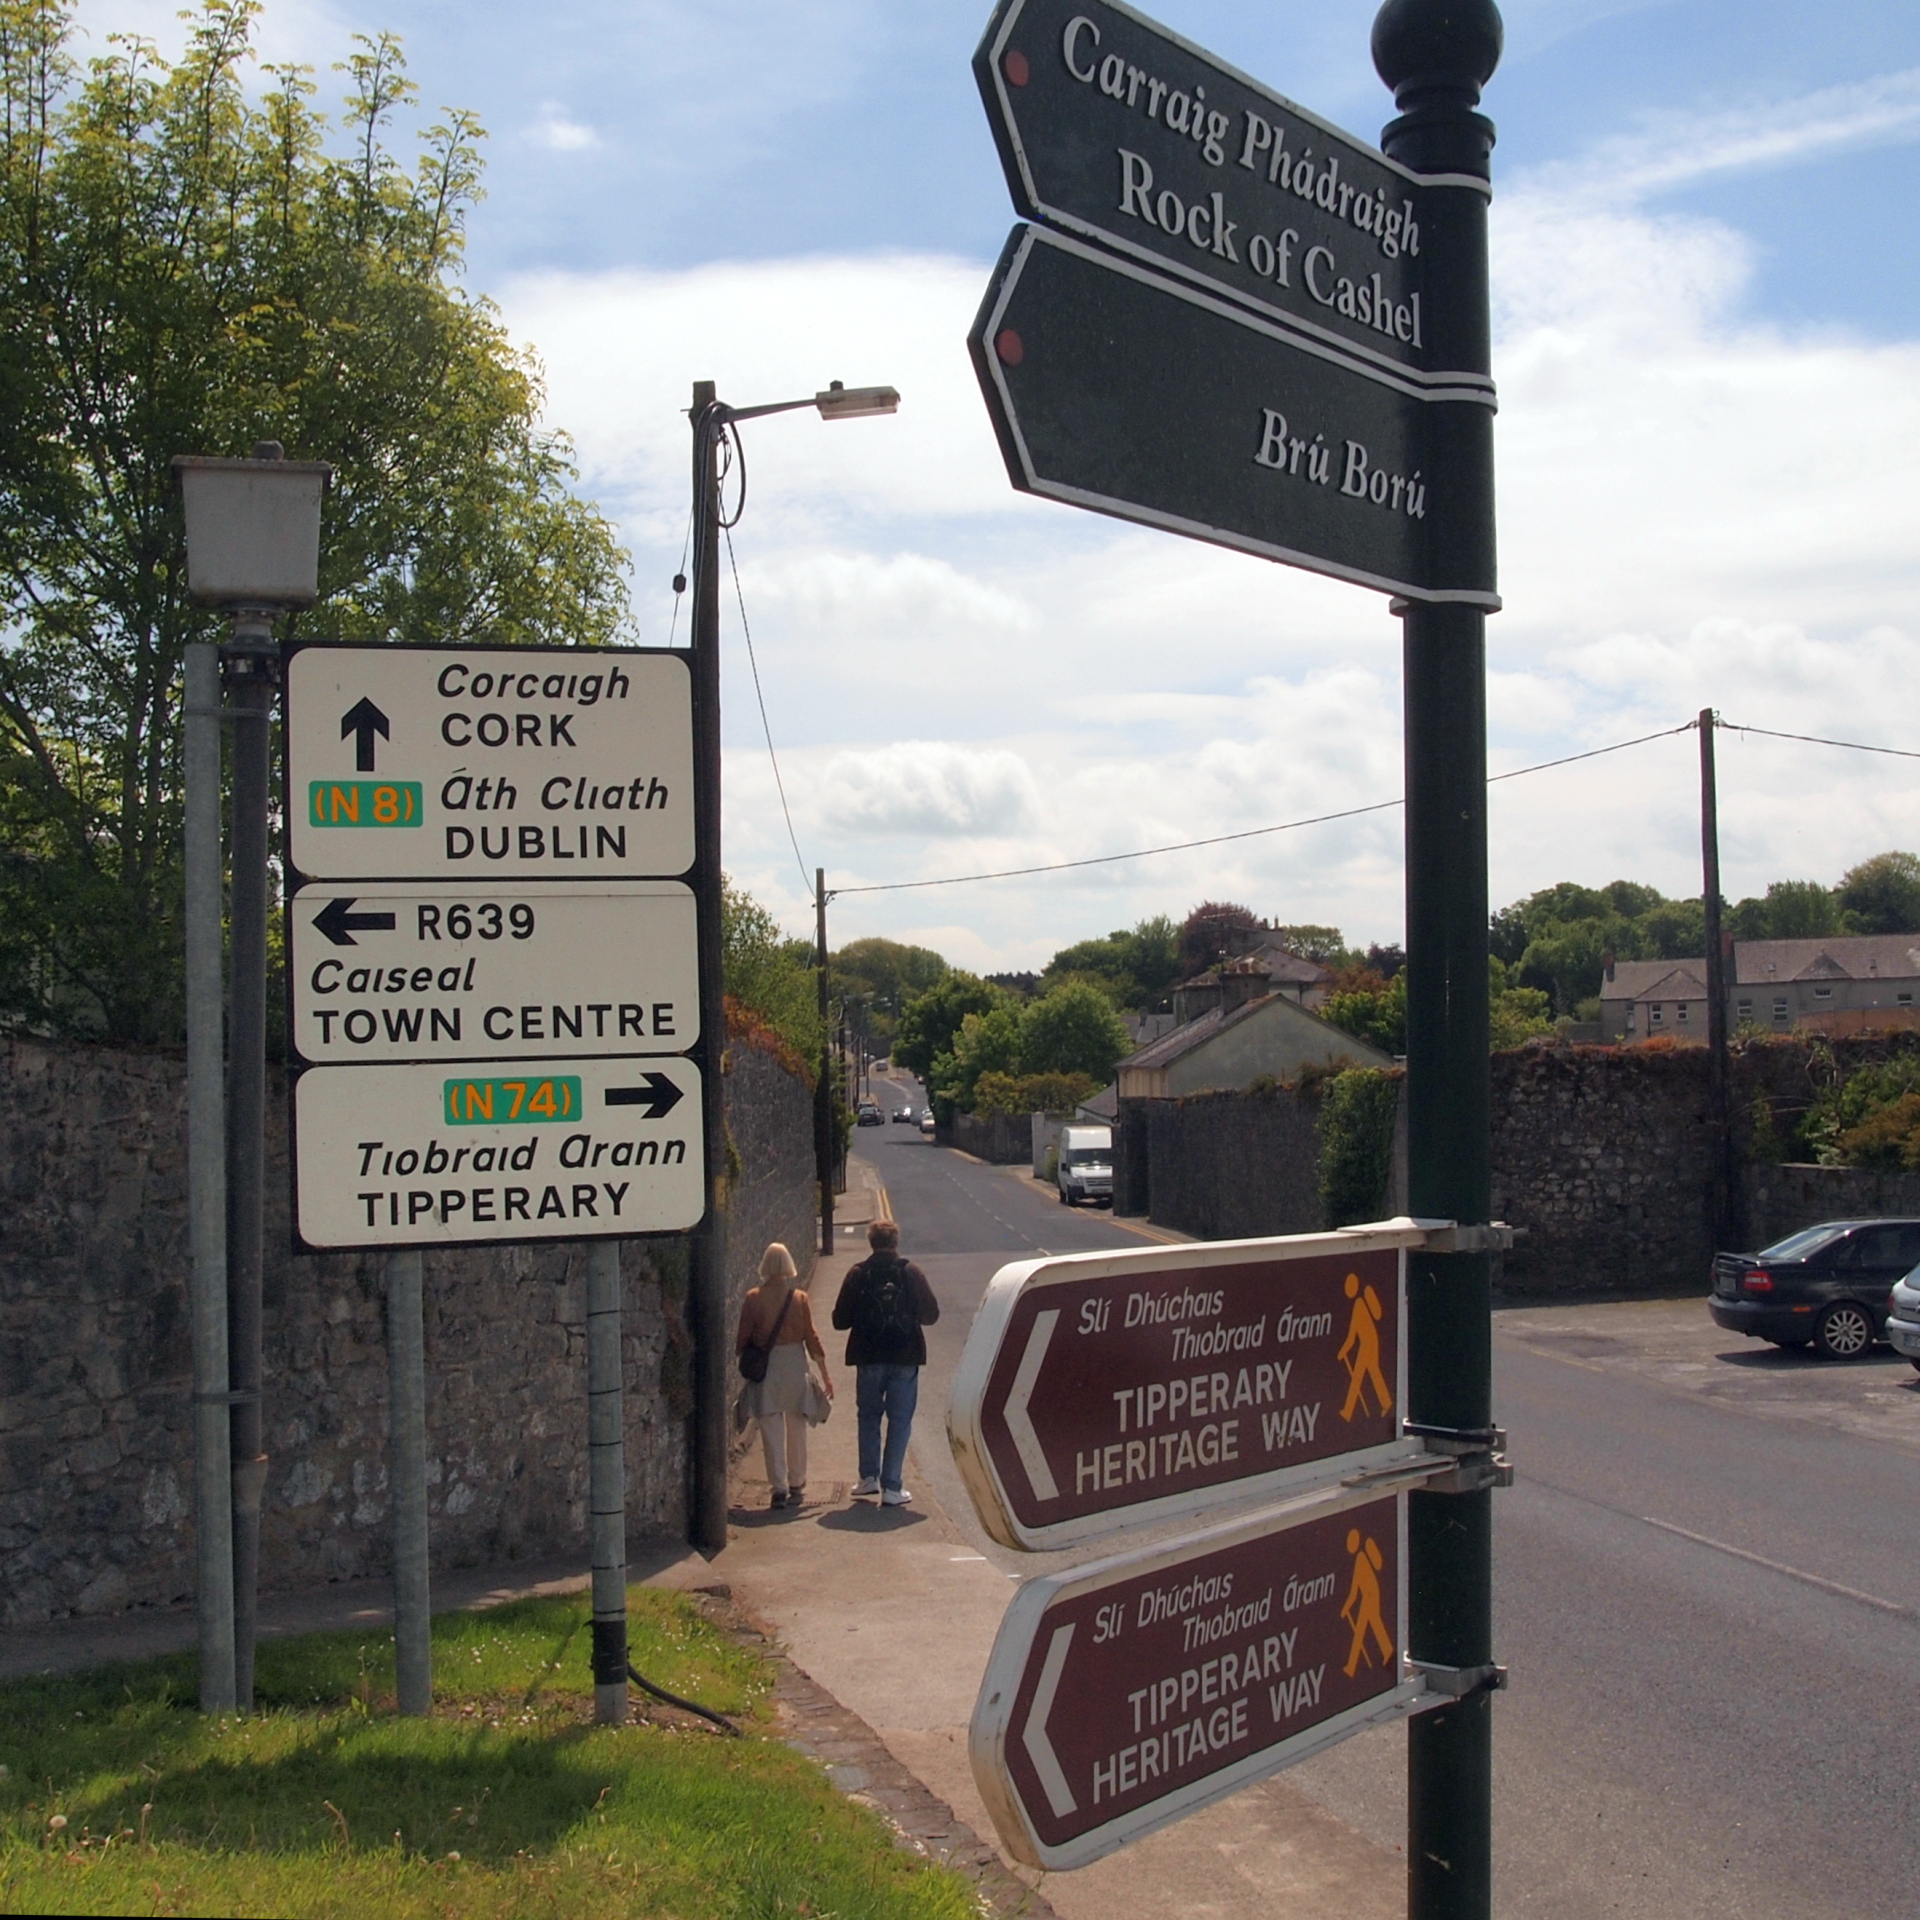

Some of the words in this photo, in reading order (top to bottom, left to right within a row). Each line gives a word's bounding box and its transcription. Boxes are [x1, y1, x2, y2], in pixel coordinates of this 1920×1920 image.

[1063, 15, 1230, 167] Carraig
[1239, 109, 1420, 258] Phádraigh
[1117, 147, 1239, 264] Rock
[1249, 228, 1299, 288] of
[1304, 245, 1423, 349] Cashel
[1254, 407, 1329, 485] Brú
[1340, 440, 1425, 520] Ború
[441, 713, 577, 747] CORK
[446, 826, 626, 859] DUBLIN
[417, 903, 535, 941] R639
[313, 1007, 462, 1044] TOWN
[483, 1003, 676, 1040] CENTRE
[357, 1182, 630, 1227] TIPPERARY
[1077, 1298, 1112, 1335] Slí
[1276, 1305, 1332, 1343] Árann
[1113, 1359, 1293, 1433] TIPPERARY
[1076, 1419, 1239, 1495] HERITAGE
[1261, 1402, 1321, 1452] WAY
[1282, 1572, 1335, 1613] Árann
[1092, 1603, 1126, 1644] Slí
[1127, 1627, 1298, 1734] TIPPERARY
[1093, 1697, 1249, 1805] HERITAGE
[1269, 1663, 1326, 1724] WAY
